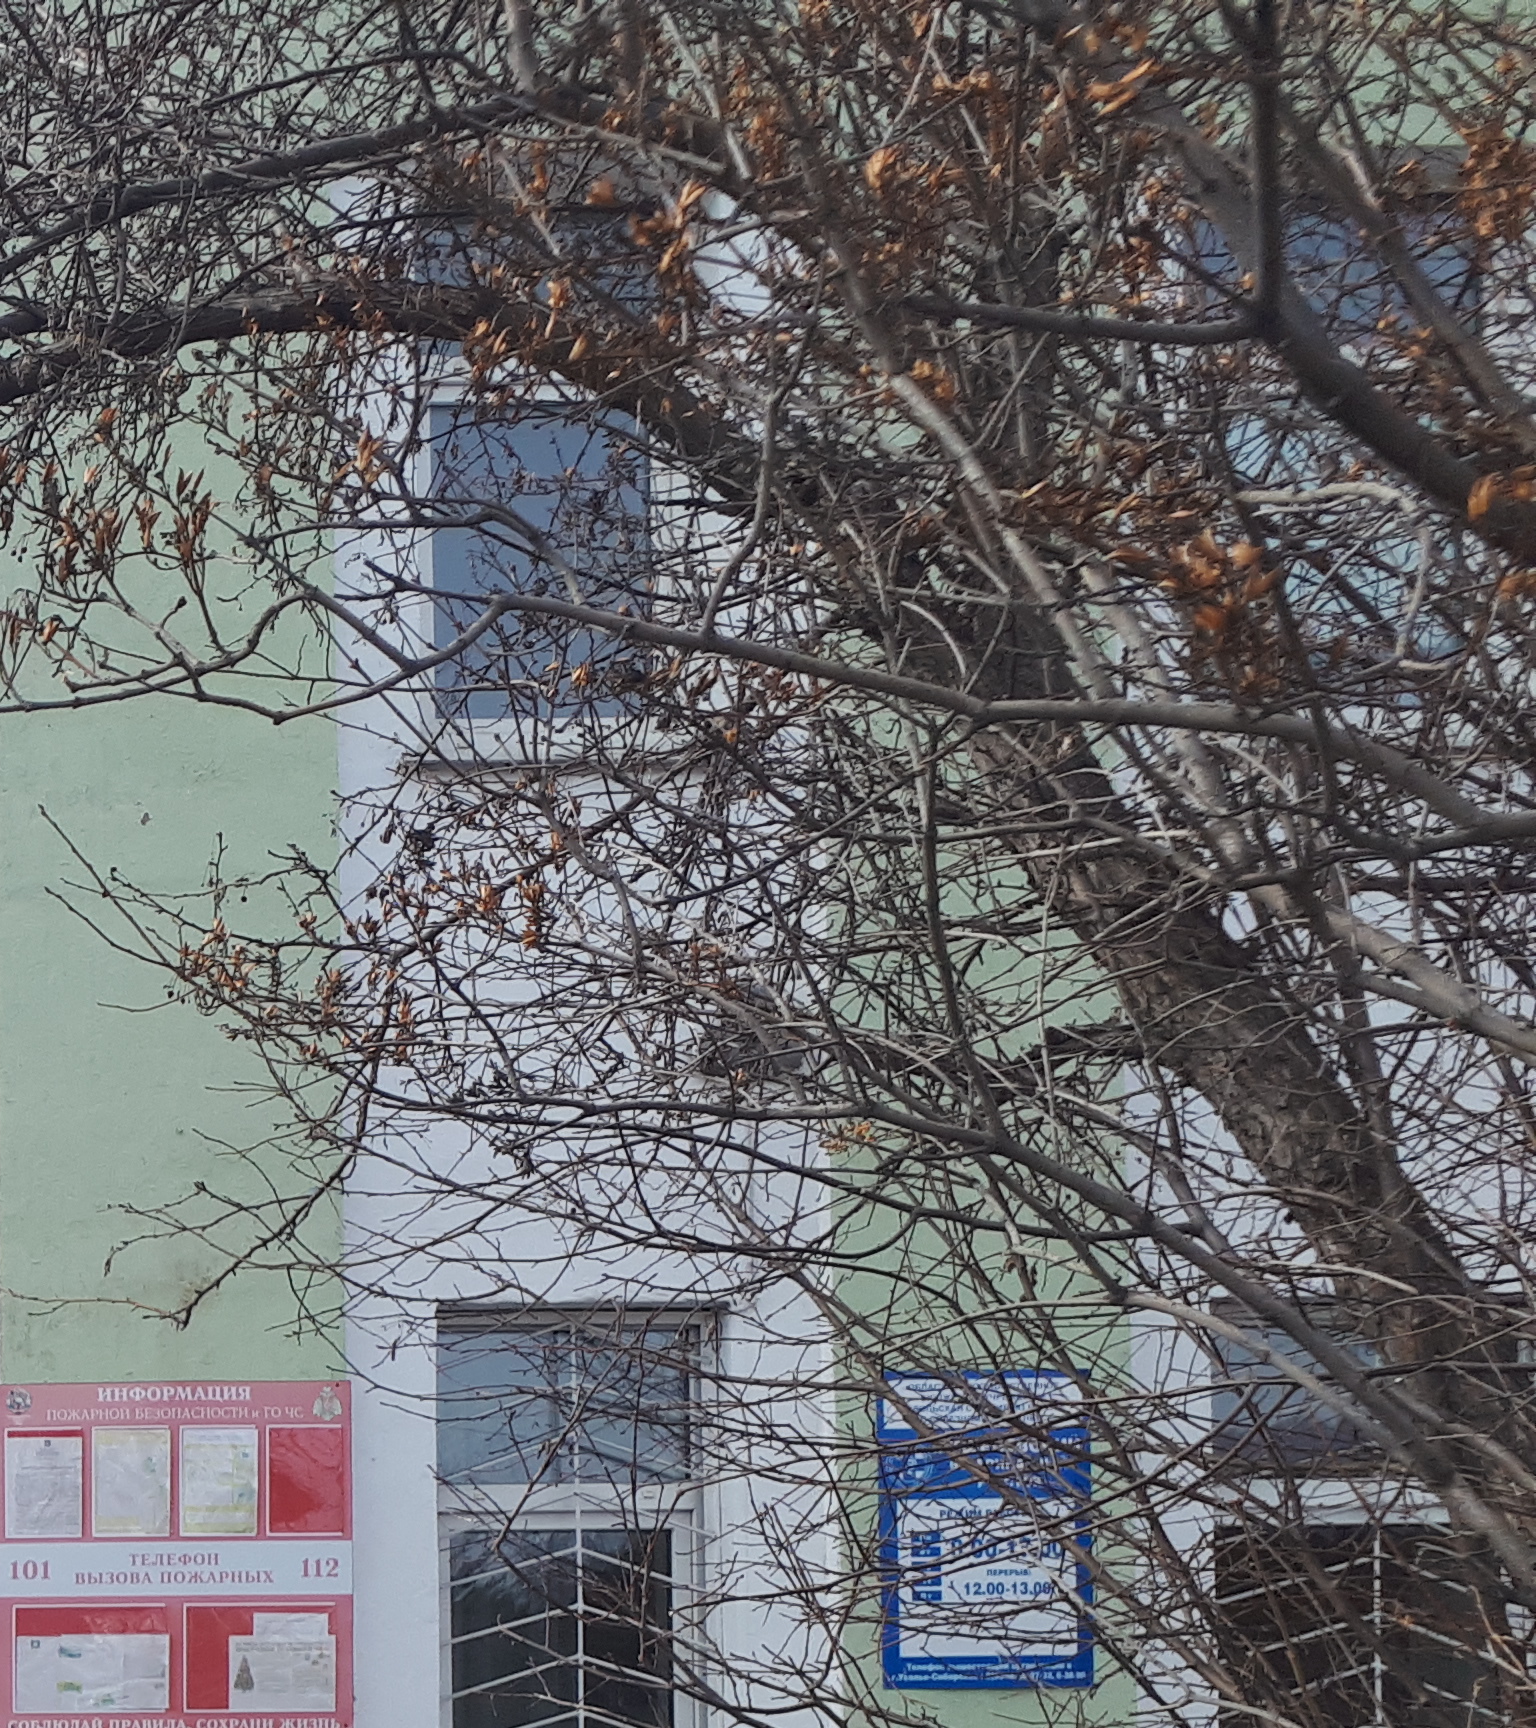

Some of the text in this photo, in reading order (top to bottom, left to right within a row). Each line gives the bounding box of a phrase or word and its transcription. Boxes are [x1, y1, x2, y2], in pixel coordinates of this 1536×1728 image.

[97, 1386, 252, 1403] ИНФОРМАЦИЯ
[46, 1407, 131, 1422] ПОЖАРНОЙ
[134, 1406, 249, 1421] БЕЗОПАСНОСТИ
[264, 1406, 282, 1419] ГО
[285, 1405, 304, 1419] ЧС
[128, 1552, 220, 1567] ТЕЛЕФОН
[9, 1560, 51, 1581] 101
[300, 1558, 340, 1579] 112
[74, 1570, 274, 1585] ВЫЗОВА ПОЖАРНЫХ
